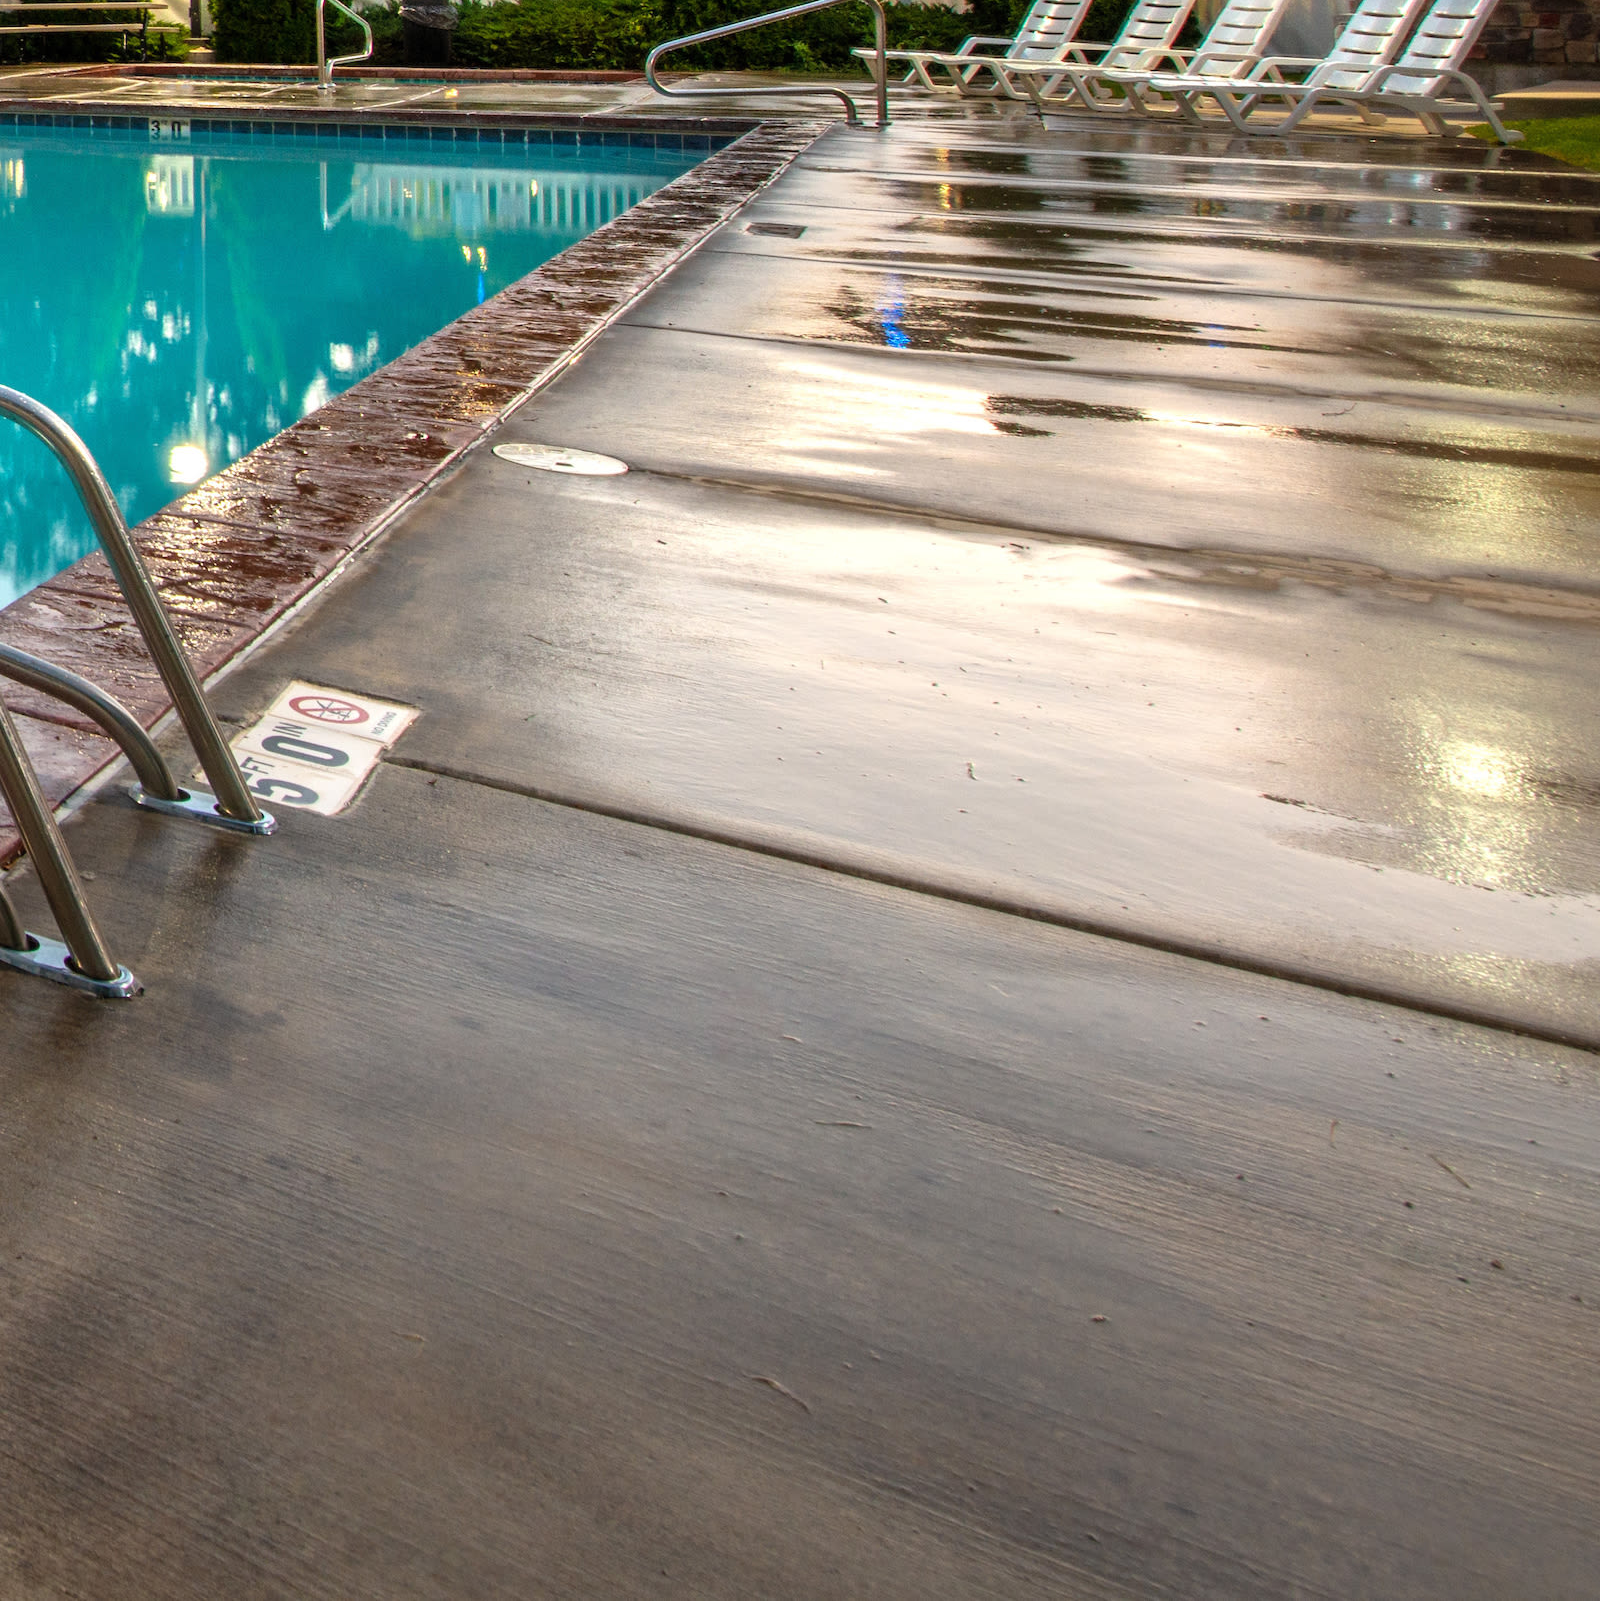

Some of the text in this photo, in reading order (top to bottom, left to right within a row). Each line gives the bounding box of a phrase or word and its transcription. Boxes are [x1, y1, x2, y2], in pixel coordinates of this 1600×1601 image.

[151, 120, 160, 131] 3
[171, 120, 181, 132] 0
[370, 711, 398, 736] NO DIVING
[240, 721, 350, 805] 5 FT 0 IN
